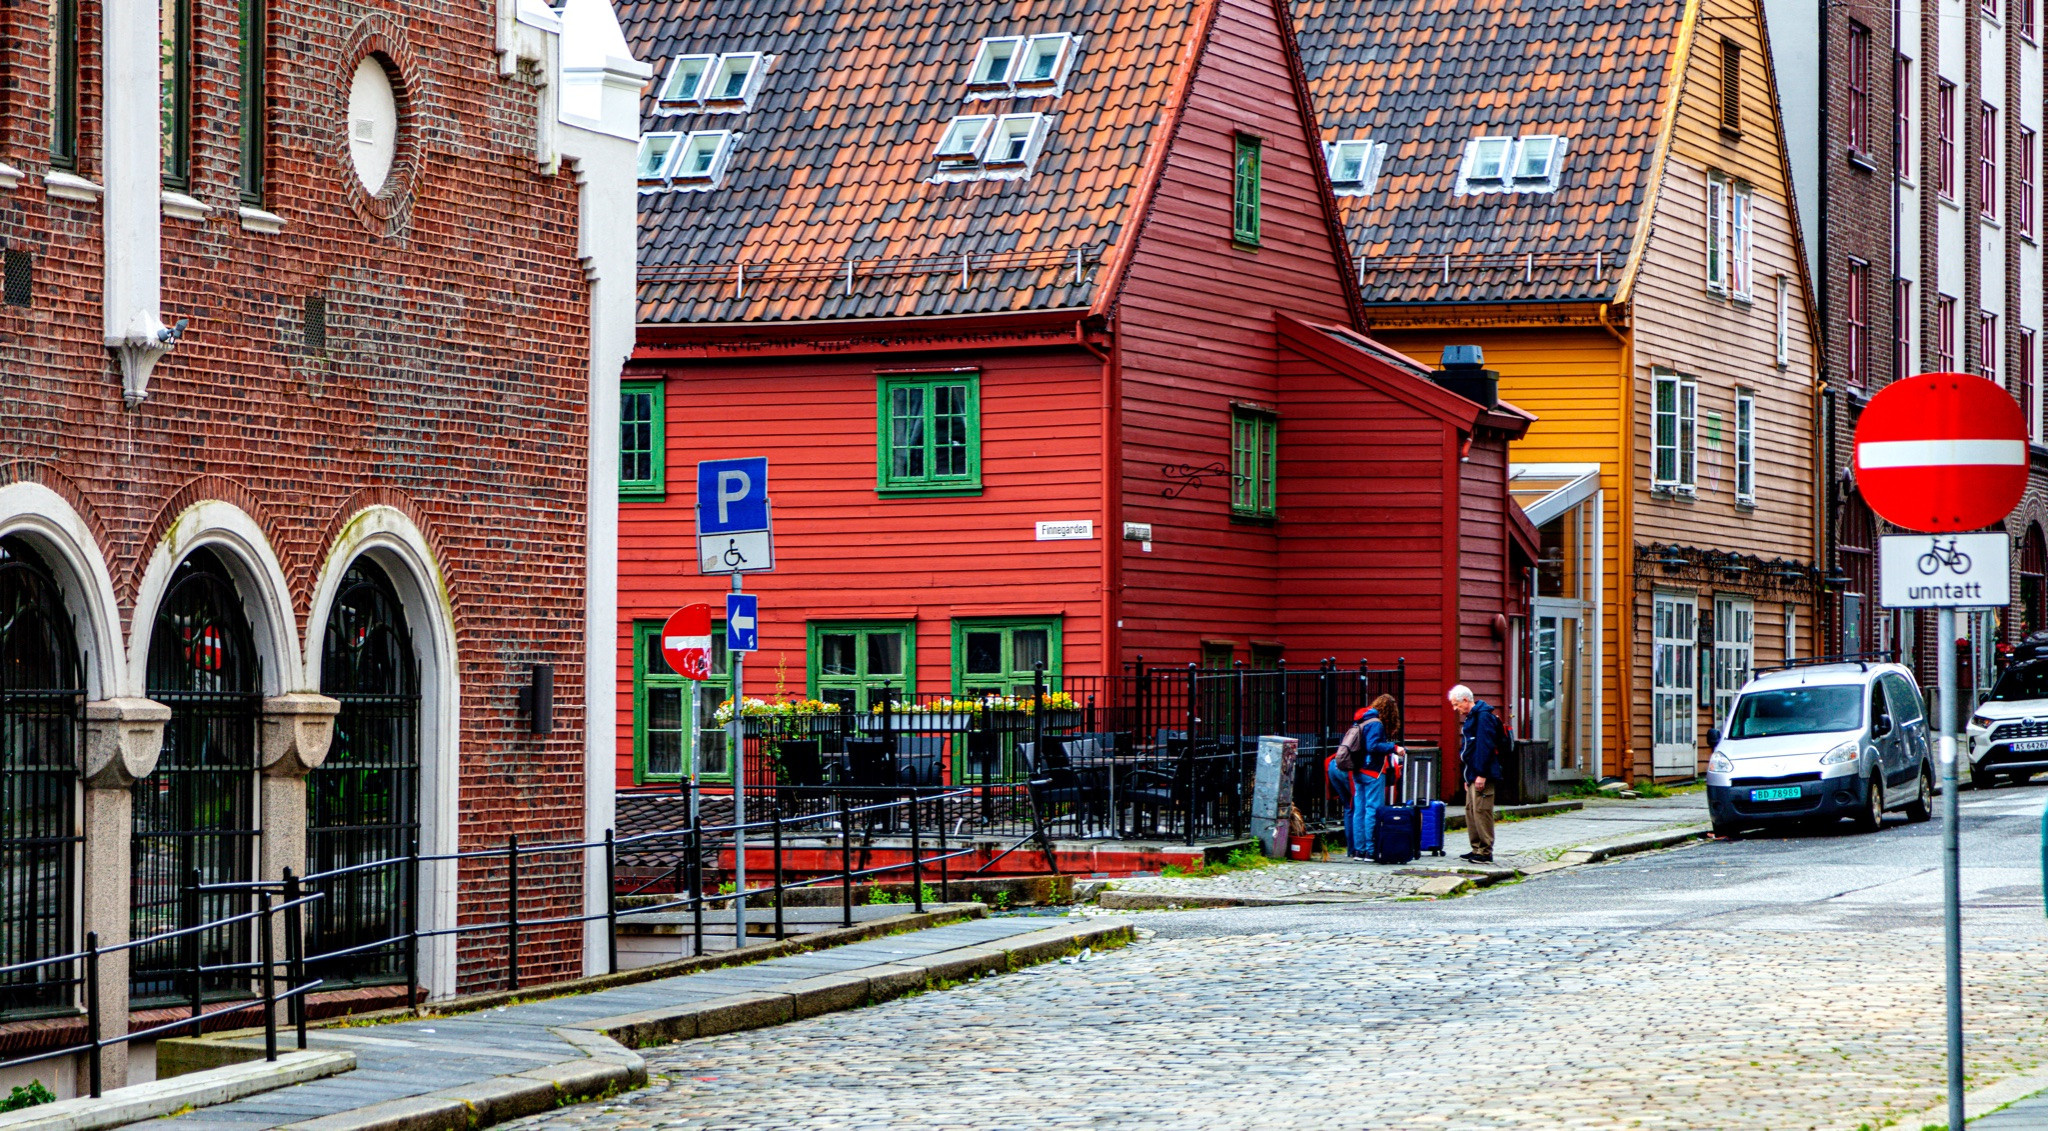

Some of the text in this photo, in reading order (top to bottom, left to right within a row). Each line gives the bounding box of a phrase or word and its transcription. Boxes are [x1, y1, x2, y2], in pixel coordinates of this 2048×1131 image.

[718, 470, 751, 524] P
[1909, 582, 1982, 599] unntatt
[1758, 788, 1799, 799] BD 78989
